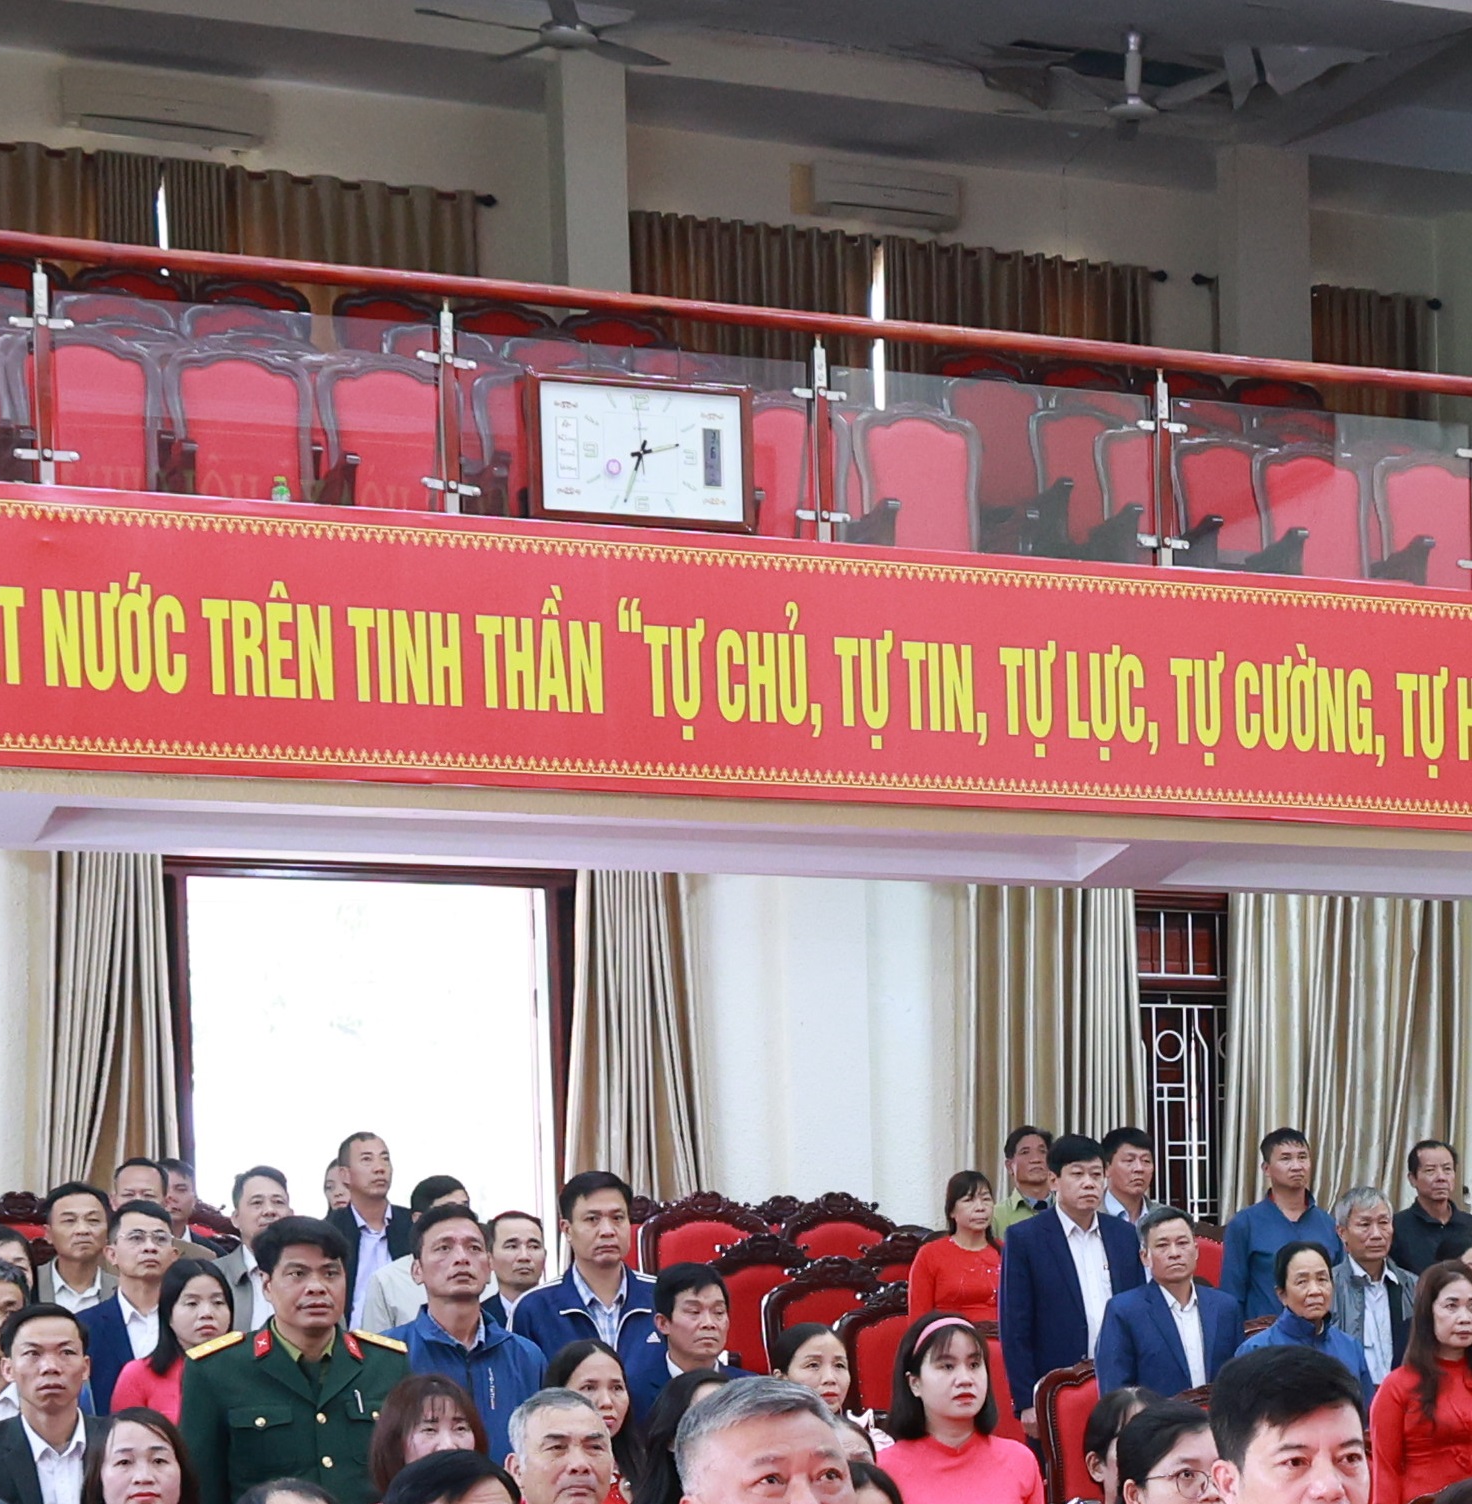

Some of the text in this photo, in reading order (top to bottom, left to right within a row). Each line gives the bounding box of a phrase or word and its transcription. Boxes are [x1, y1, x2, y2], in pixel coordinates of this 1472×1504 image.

[43, 555, 187, 694] NƯỚC
[203, 582, 334, 700] TRÊN
[349, 608, 463, 706] TINH
[477, 584, 604, 713] THẦN
[718, 604, 822, 736] CHỦ,
[835, 632, 893, 746] TỰ
[903, 642, 987, 744] TIN,
[1001, 643, 1057, 754] TỰ
[1068, 647, 1158, 760] LỰC,
[1171, 653, 1225, 764] TỰ
[1236, 646, 1385, 766] CƯỜNG,
[1398, 669, 1449, 778] TỰ
